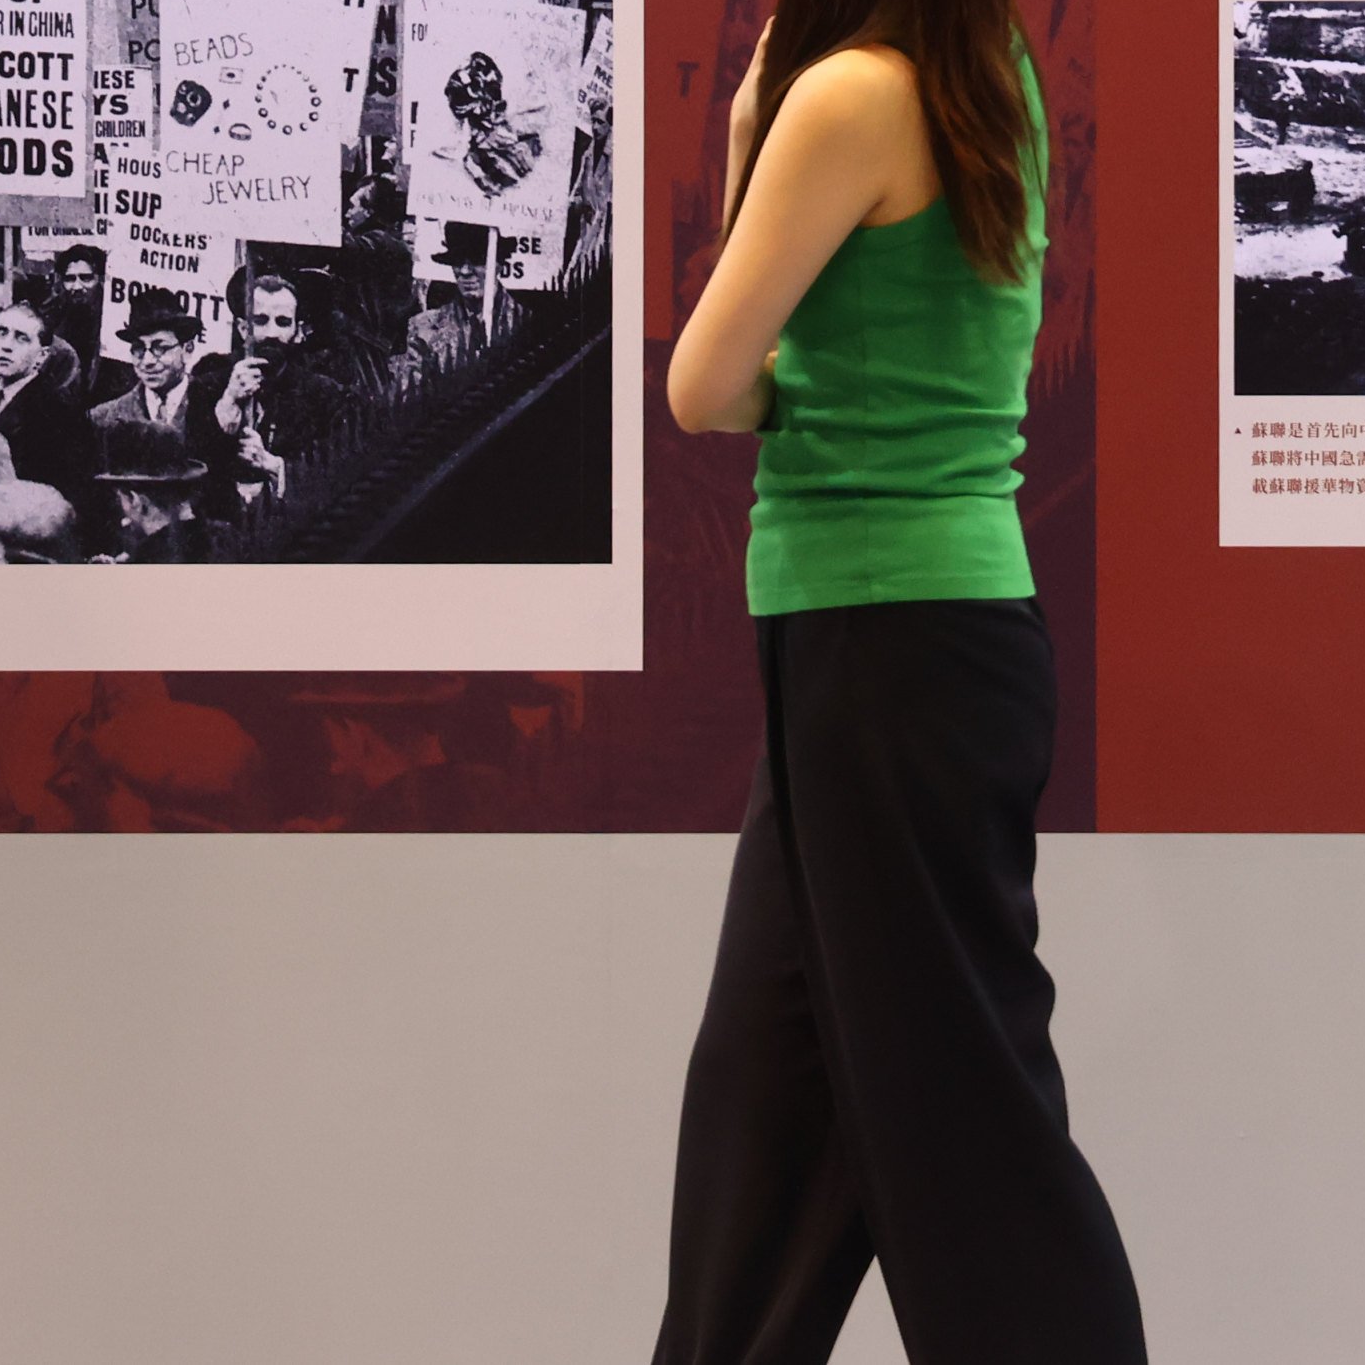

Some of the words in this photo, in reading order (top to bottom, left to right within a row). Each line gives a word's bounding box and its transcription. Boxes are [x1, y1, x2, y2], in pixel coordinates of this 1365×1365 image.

[9, 10, 25, 37] IN
[28, 12, 75, 39] CHINA
[174, 33, 254, 67] BEADS
[95, 120, 146, 138] CHILDREN
[166, 151, 245, 176] CHEAP
[202, 175, 311, 205] JEWELRY
[139, 248, 200, 274] ACTION
